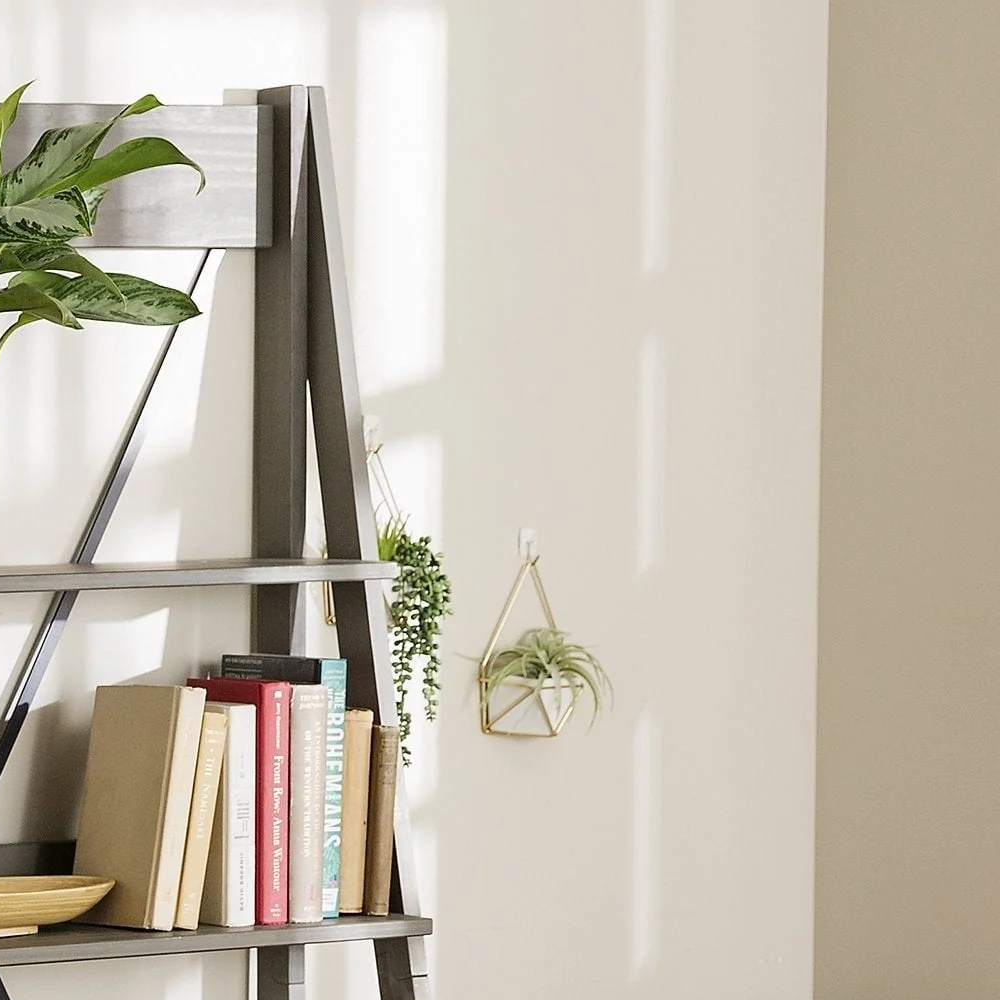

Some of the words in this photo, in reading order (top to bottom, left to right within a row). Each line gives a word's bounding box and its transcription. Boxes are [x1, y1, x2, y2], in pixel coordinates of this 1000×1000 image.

[334, 689, 346, 710] THE
[324, 713, 345, 848] BOHEMIANS
[272, 816, 283, 846] Anna
[303, 811, 311, 858] TRADITION
[272, 847, 283, 892] Wintour
